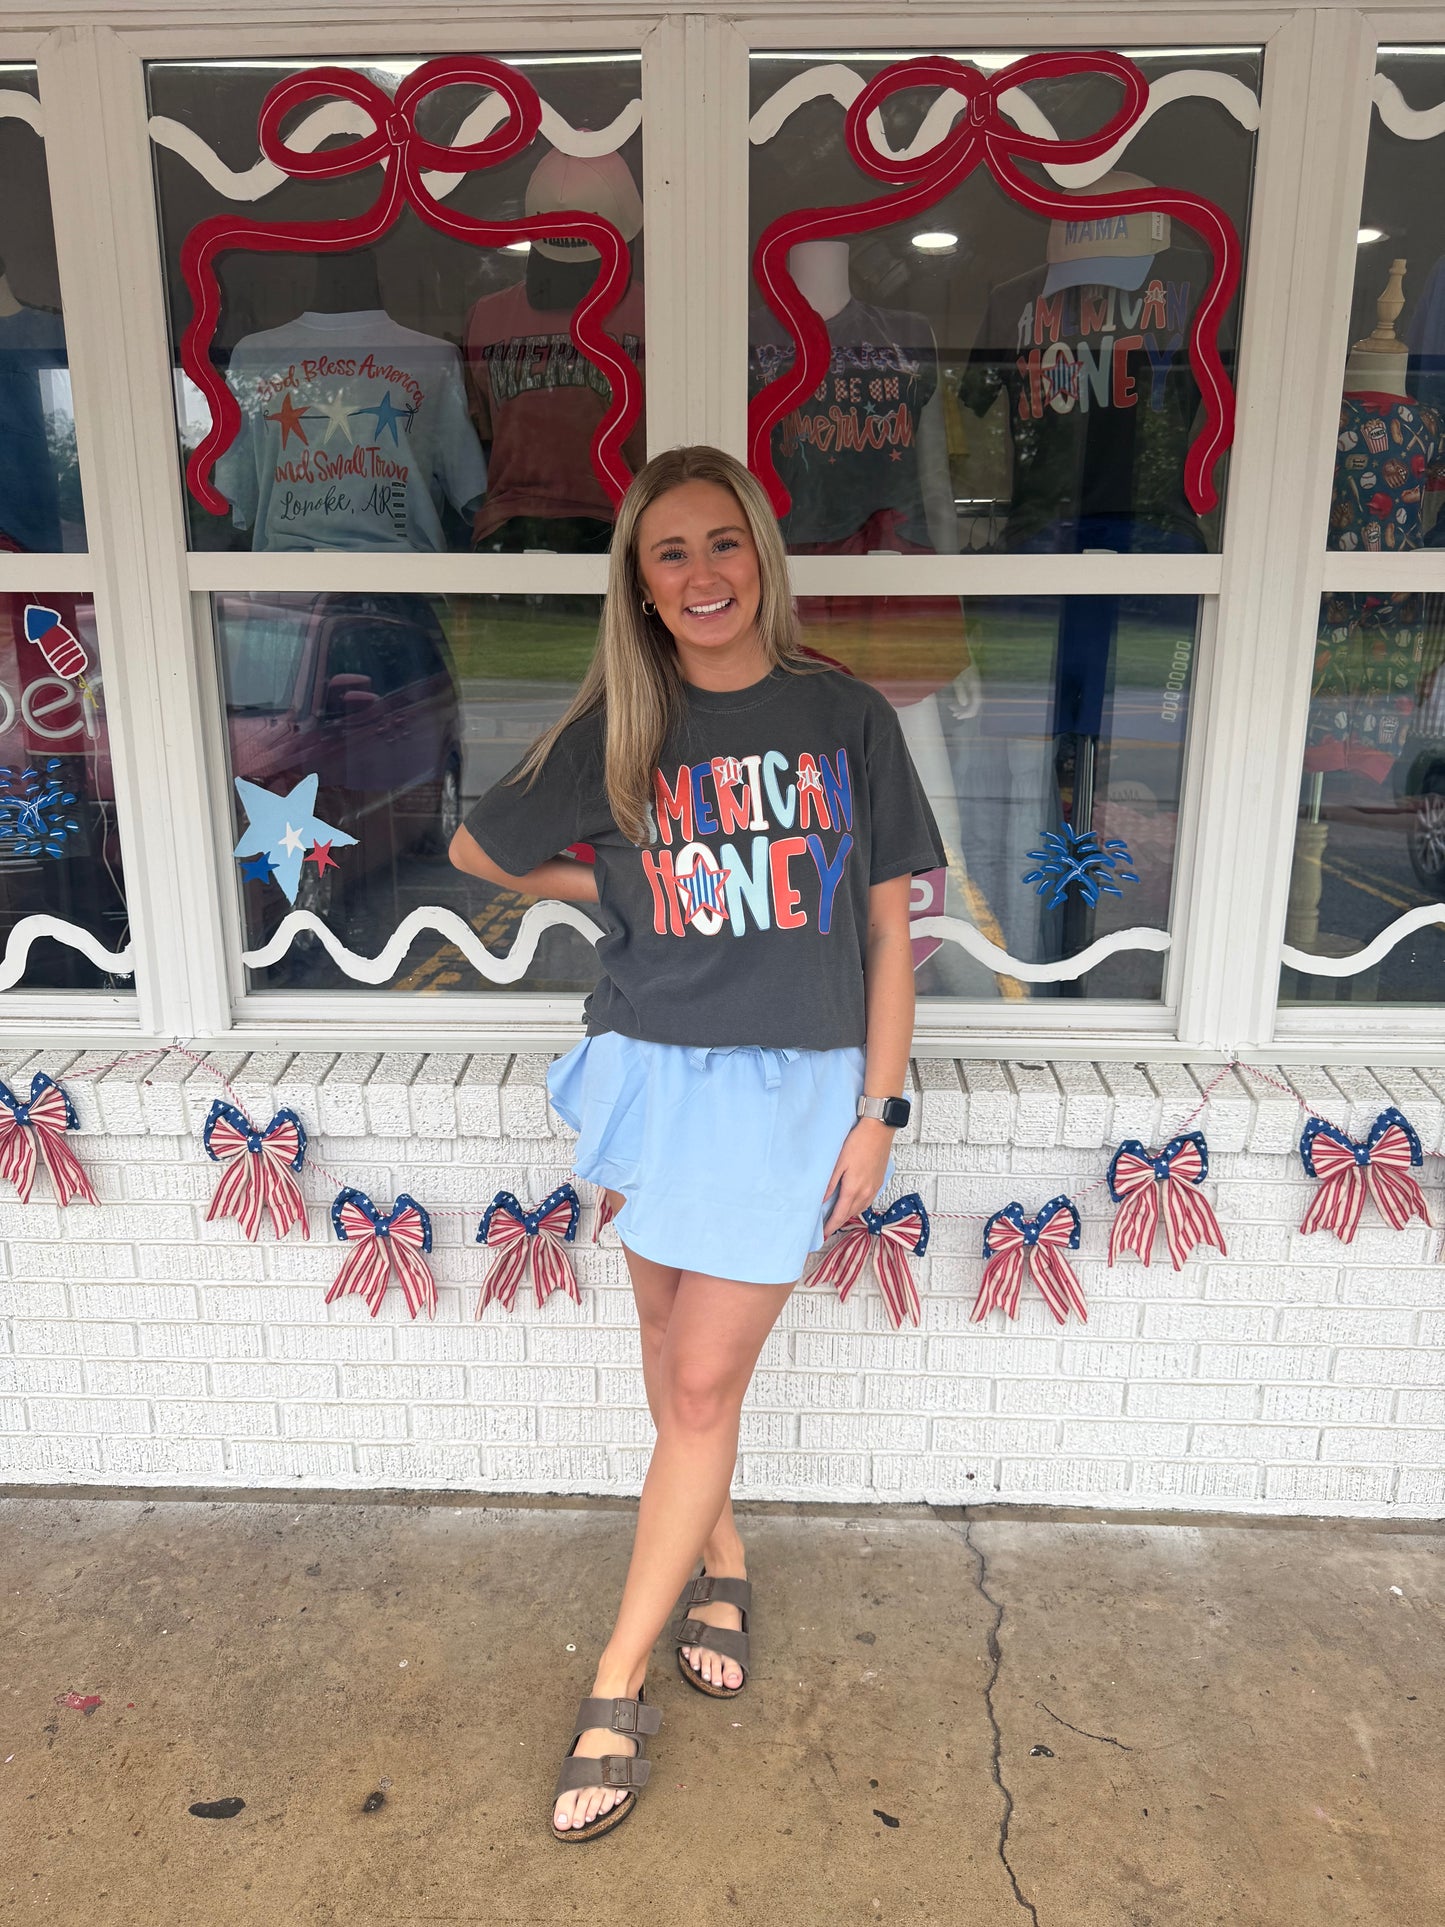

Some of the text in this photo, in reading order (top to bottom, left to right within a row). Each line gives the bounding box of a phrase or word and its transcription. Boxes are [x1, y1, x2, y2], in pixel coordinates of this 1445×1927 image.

[1065, 216, 1128, 245] MAMA
[301, 355, 356, 382] Bless
[358, 354, 425, 408] America
[834, 377, 861, 402] BE
[869, 376, 900, 401] AN
[1016, 333, 1184, 420] HONEY
[314, 444, 367, 482] Small
[366, 446, 408, 483] Town
[361, 483, 395, 519] AR
[645, 748, 853, 846] MERICAN
[641, 832, 854, 938] HONEY
